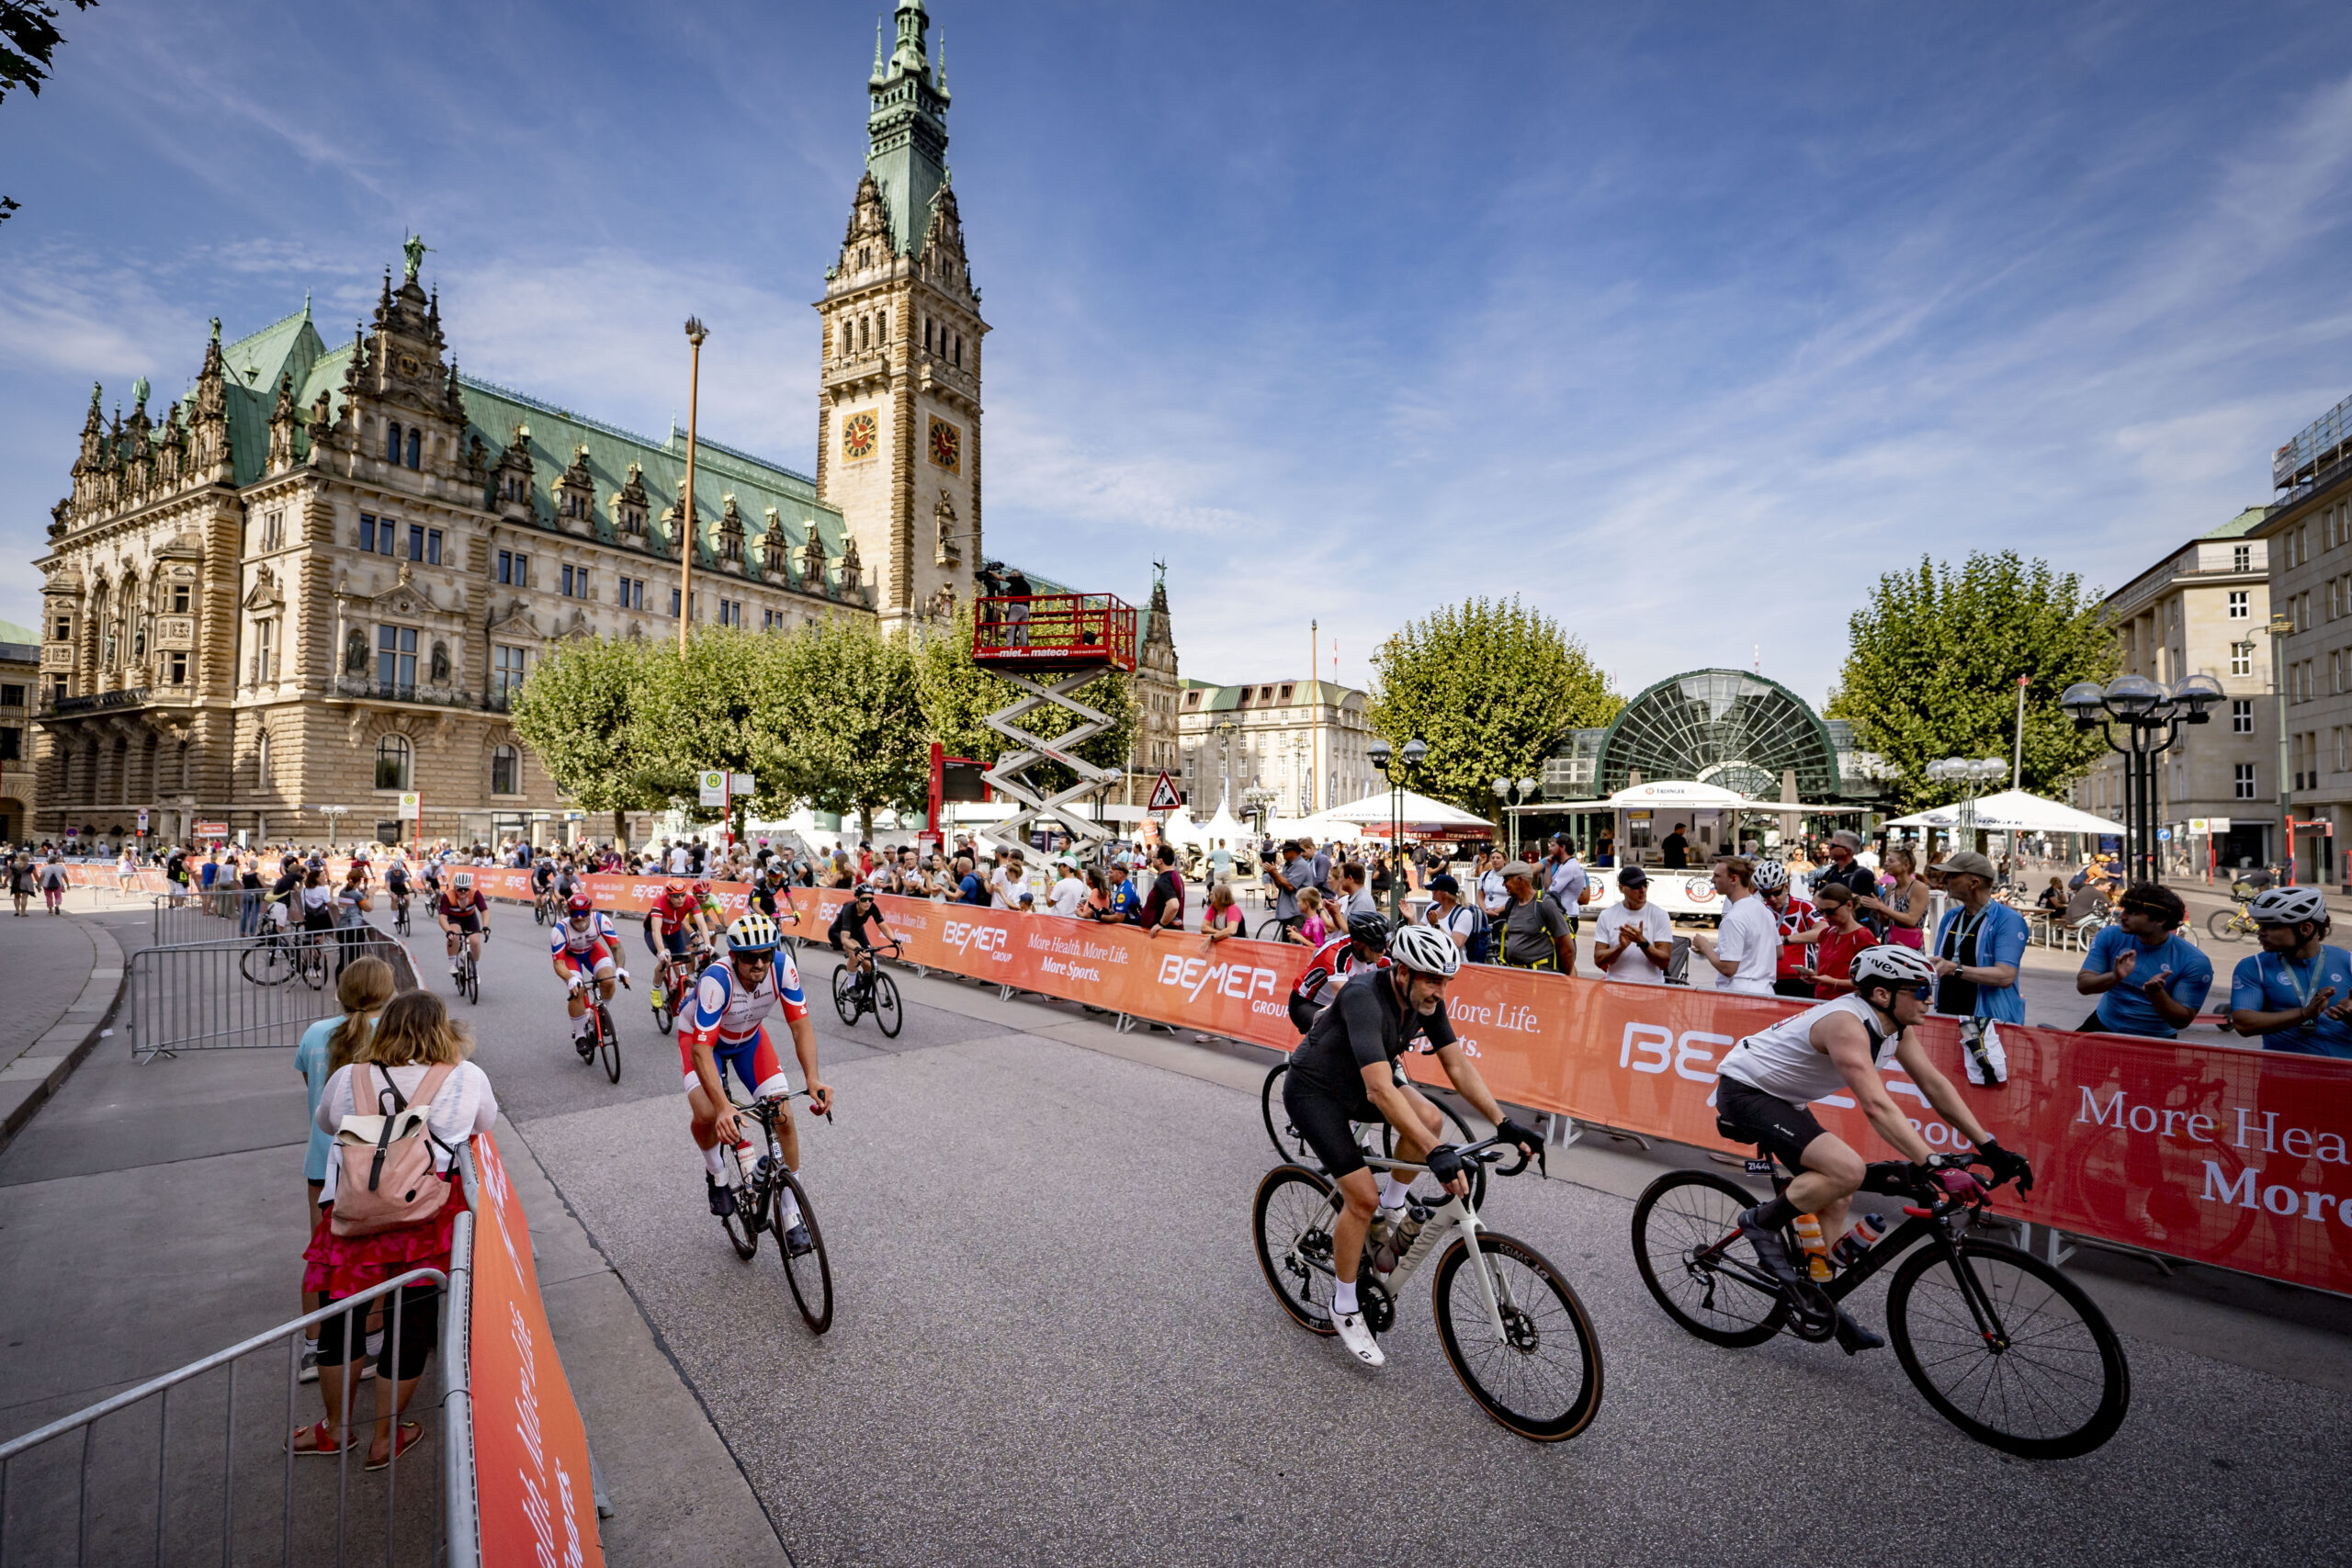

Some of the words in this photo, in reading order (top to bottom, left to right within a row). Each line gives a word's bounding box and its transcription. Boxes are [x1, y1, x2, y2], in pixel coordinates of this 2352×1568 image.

[1031, 648, 1069, 658] mateco
[1044, 749, 1069, 763] mateco
[631, 884, 664, 903] BEMER
[943, 920, 1008, 956] BEMER
[1027, 933, 1051, 952] More
[1082, 942, 1108, 961] More
[1109, 944, 1129, 964] Life.
[992, 951, 1012, 963] GROUP
[1041, 955, 1066, 976] More
[1067, 961, 1101, 982] Sports.
[1158, 954, 1277, 1004] BEMER
[1496, 1002, 1541, 1033] Life.
[2076, 1085, 2214, 1143] More
[2233, 1107, 2352, 1165] Hea
[1399, 1222, 1442, 1272] CANYON
[1499, 1243, 1530, 1265] SWISS
[1532, 1259, 1550, 1280] DT
